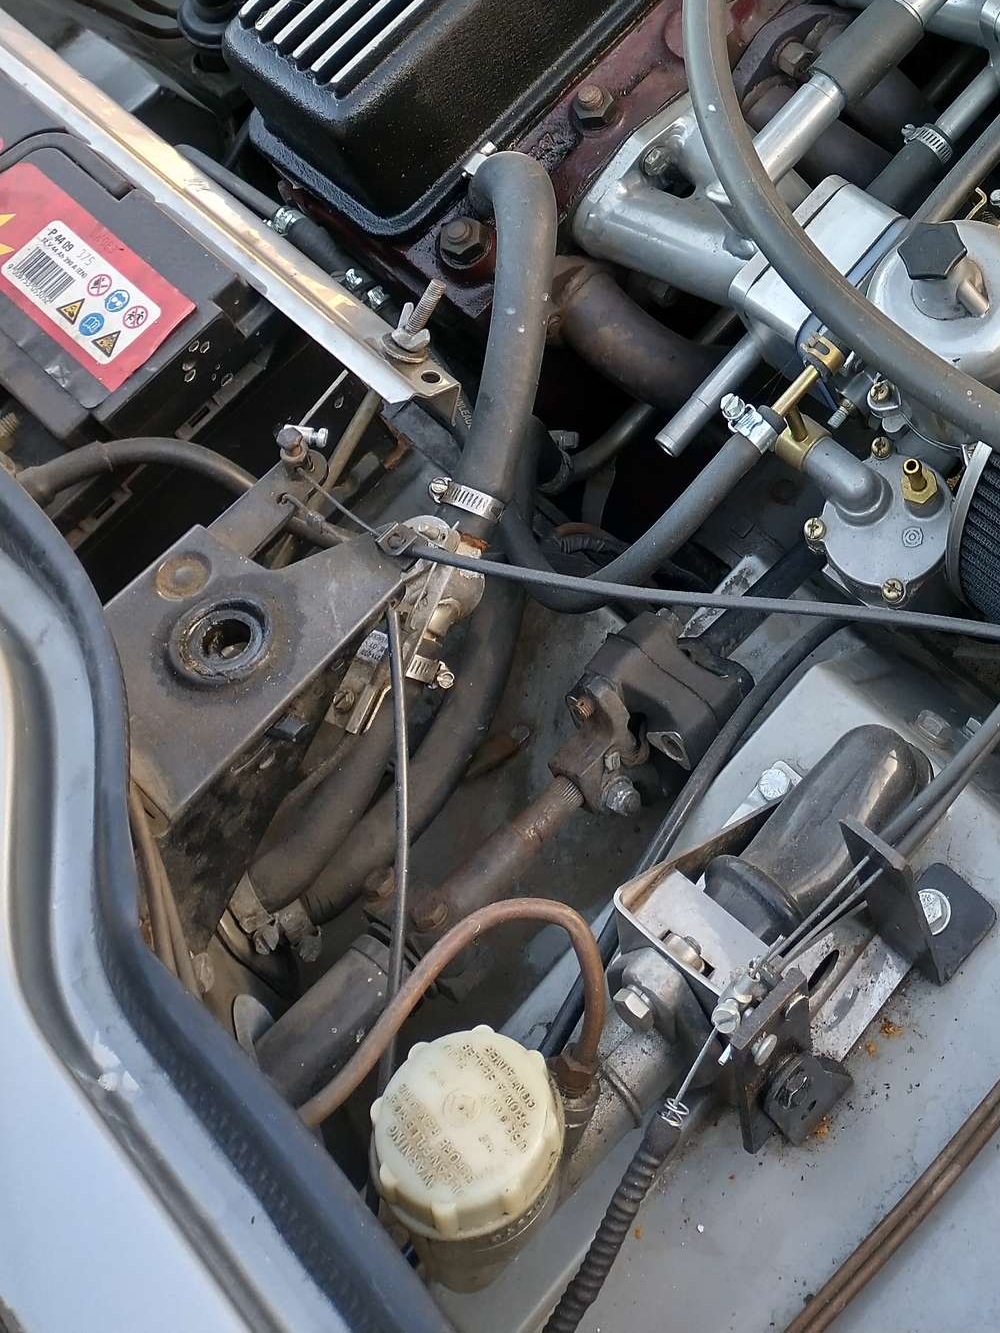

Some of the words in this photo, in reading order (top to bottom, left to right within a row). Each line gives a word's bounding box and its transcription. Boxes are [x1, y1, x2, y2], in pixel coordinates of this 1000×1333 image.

[48, 228, 58, 236] P
[55, 234, 66, 245] 44
[62, 241, 74, 252] 09
[388, 1124, 433, 1191] WARNING
